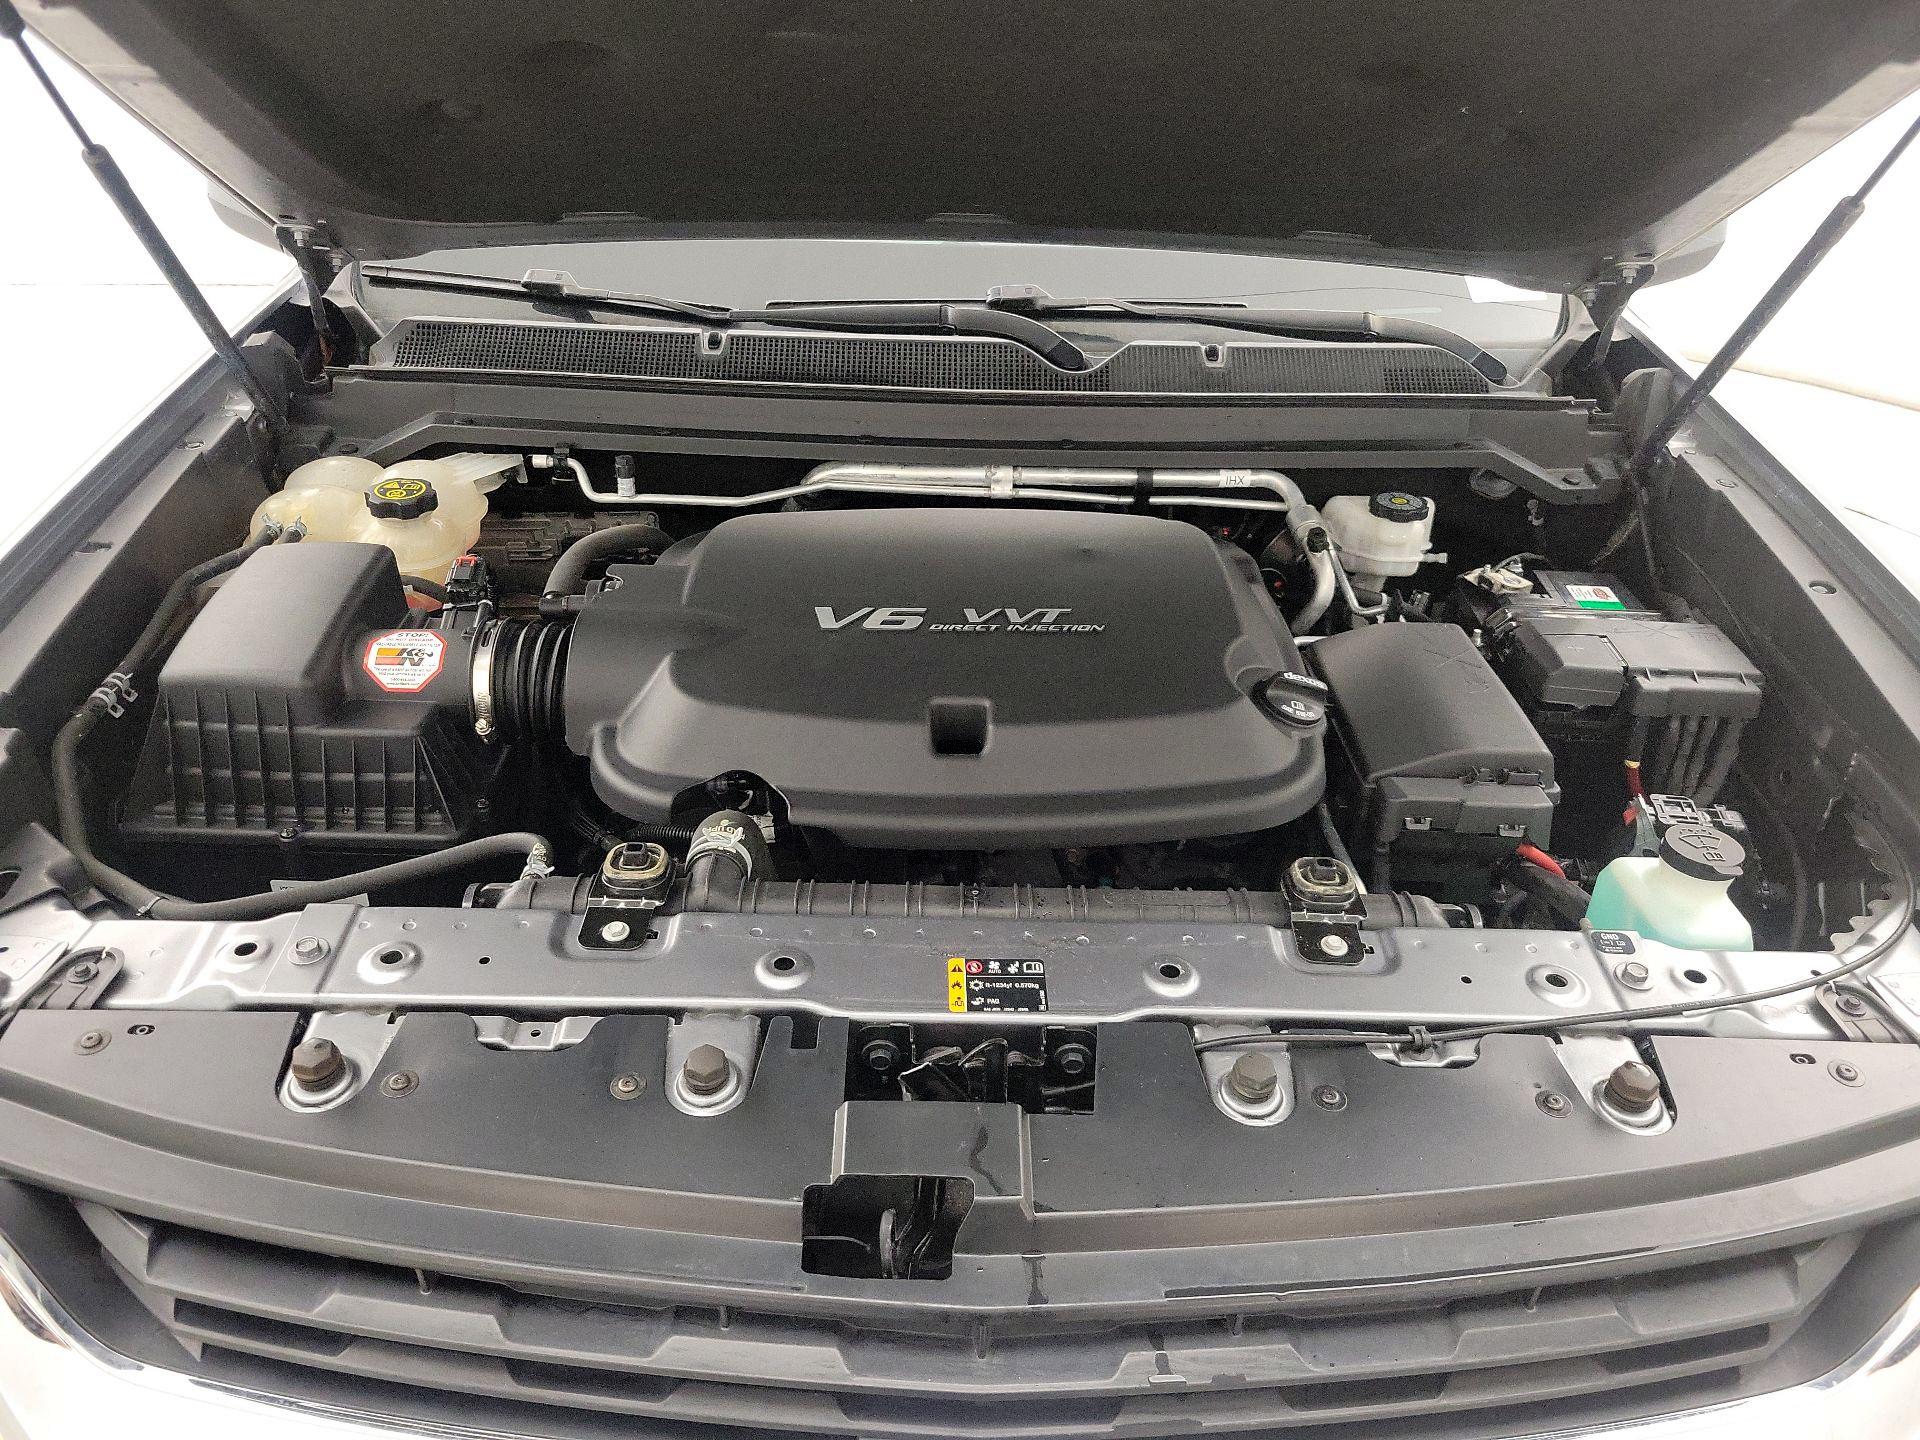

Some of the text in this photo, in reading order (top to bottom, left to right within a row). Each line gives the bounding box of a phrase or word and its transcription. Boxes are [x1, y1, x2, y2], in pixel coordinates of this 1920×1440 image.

[814, 606, 1073, 630] V6 VVT
[929, 624, 1106, 632] DIRECT INJECTION
[1600, 932, 1619, 941] GND
